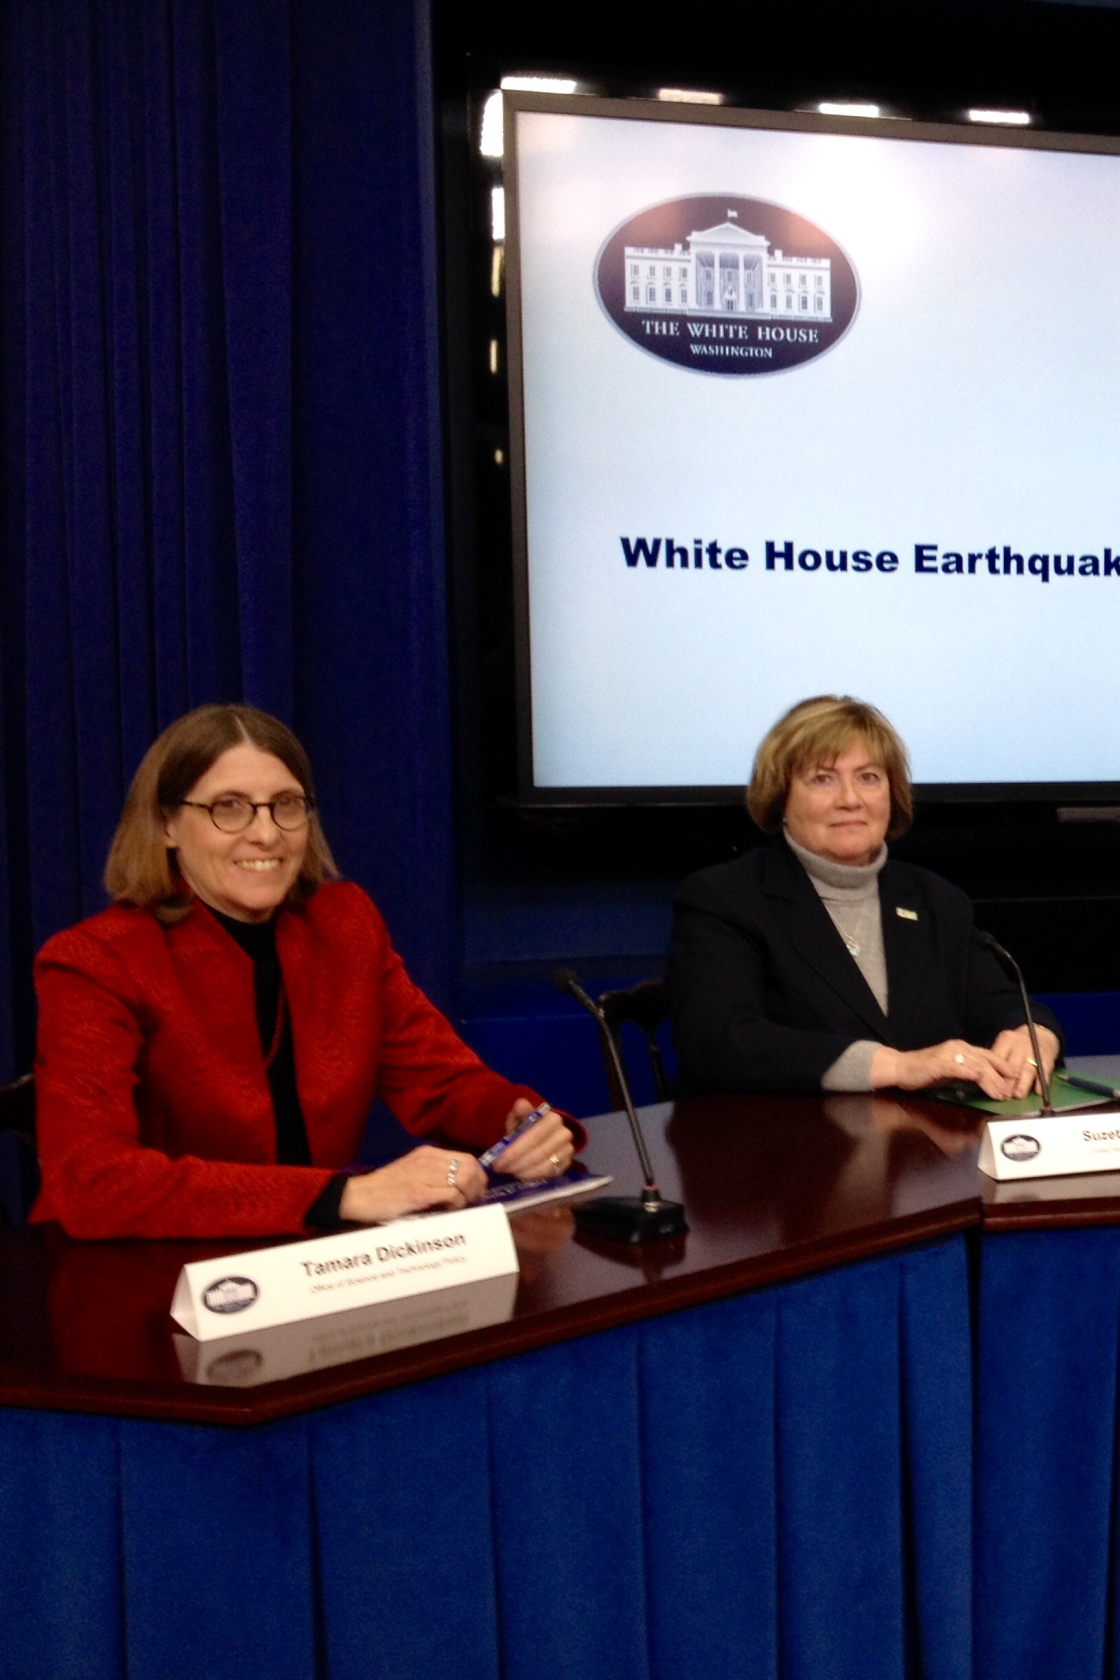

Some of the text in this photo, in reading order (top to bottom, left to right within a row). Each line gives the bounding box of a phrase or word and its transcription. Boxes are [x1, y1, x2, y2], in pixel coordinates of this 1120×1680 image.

[642, 320, 819, 343] THE WHITE HOUSE
[690, 343, 773, 358] WASHINGTON
[620, 537, 750, 571] White
[765, 540, 899, 573] House
[300, 1233, 467, 1277] Tamara Dickinson
